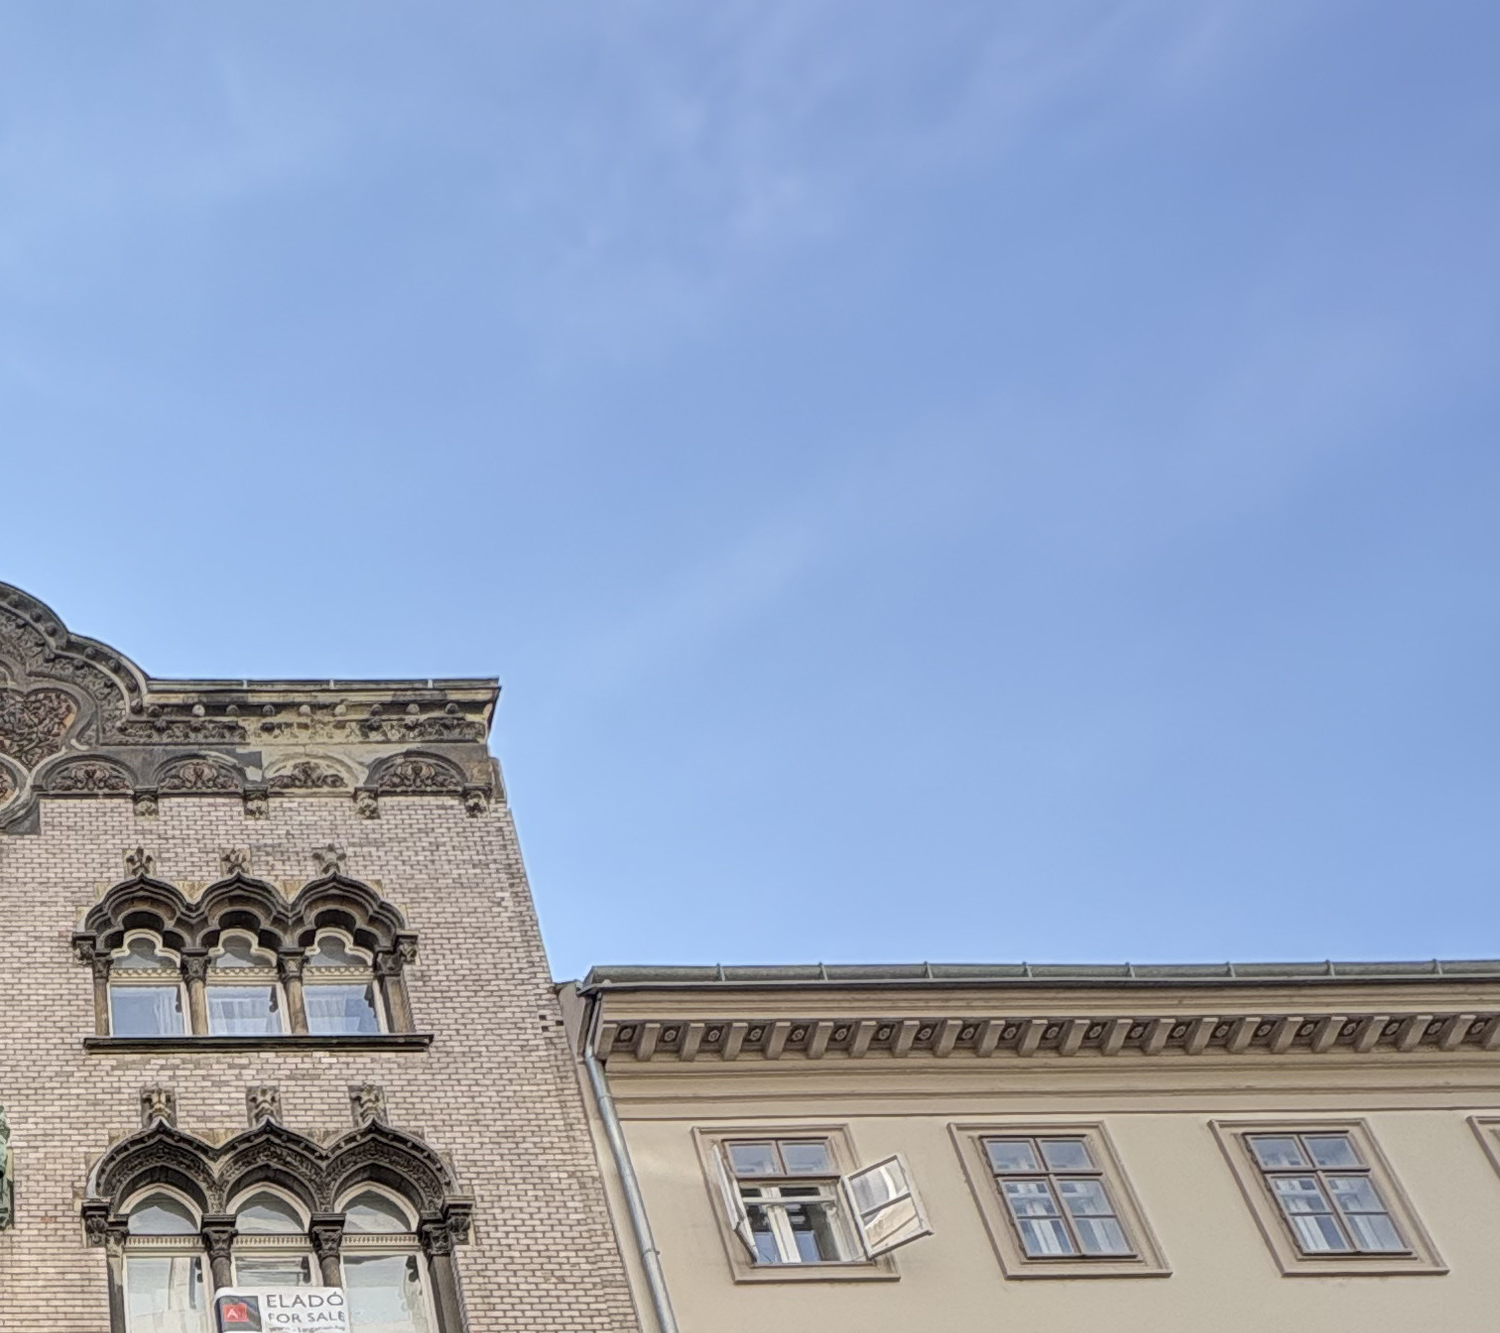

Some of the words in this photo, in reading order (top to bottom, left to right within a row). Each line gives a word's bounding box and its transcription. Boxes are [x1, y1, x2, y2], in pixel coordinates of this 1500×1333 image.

[266, 1291, 344, 1309] ELADÓ
[268, 1312, 302, 1324] FOR
[307, 1311, 346, 1323] SALE
